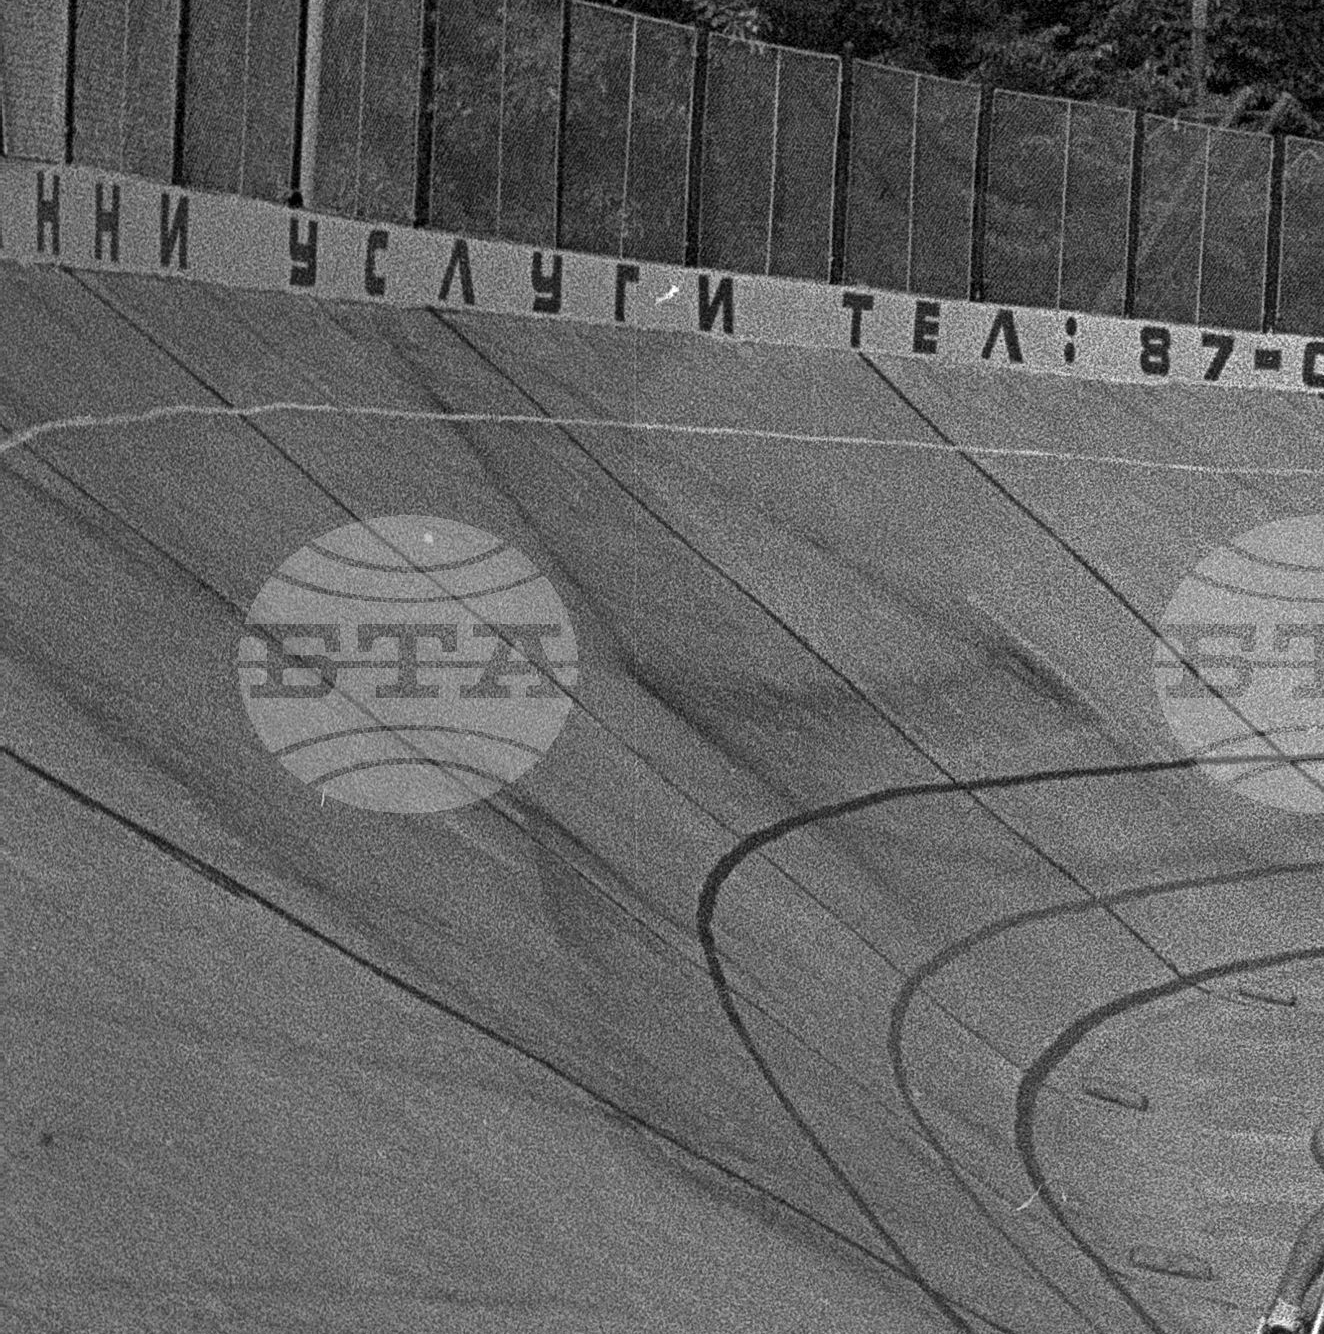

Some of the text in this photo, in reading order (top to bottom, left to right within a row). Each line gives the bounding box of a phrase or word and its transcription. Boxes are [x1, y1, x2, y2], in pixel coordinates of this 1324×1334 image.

[0, 170, 189, 271] ННИ
[288, 218, 734, 334] УСЛУГИ
[841, 292, 1077, 365] ТЕЛ:
